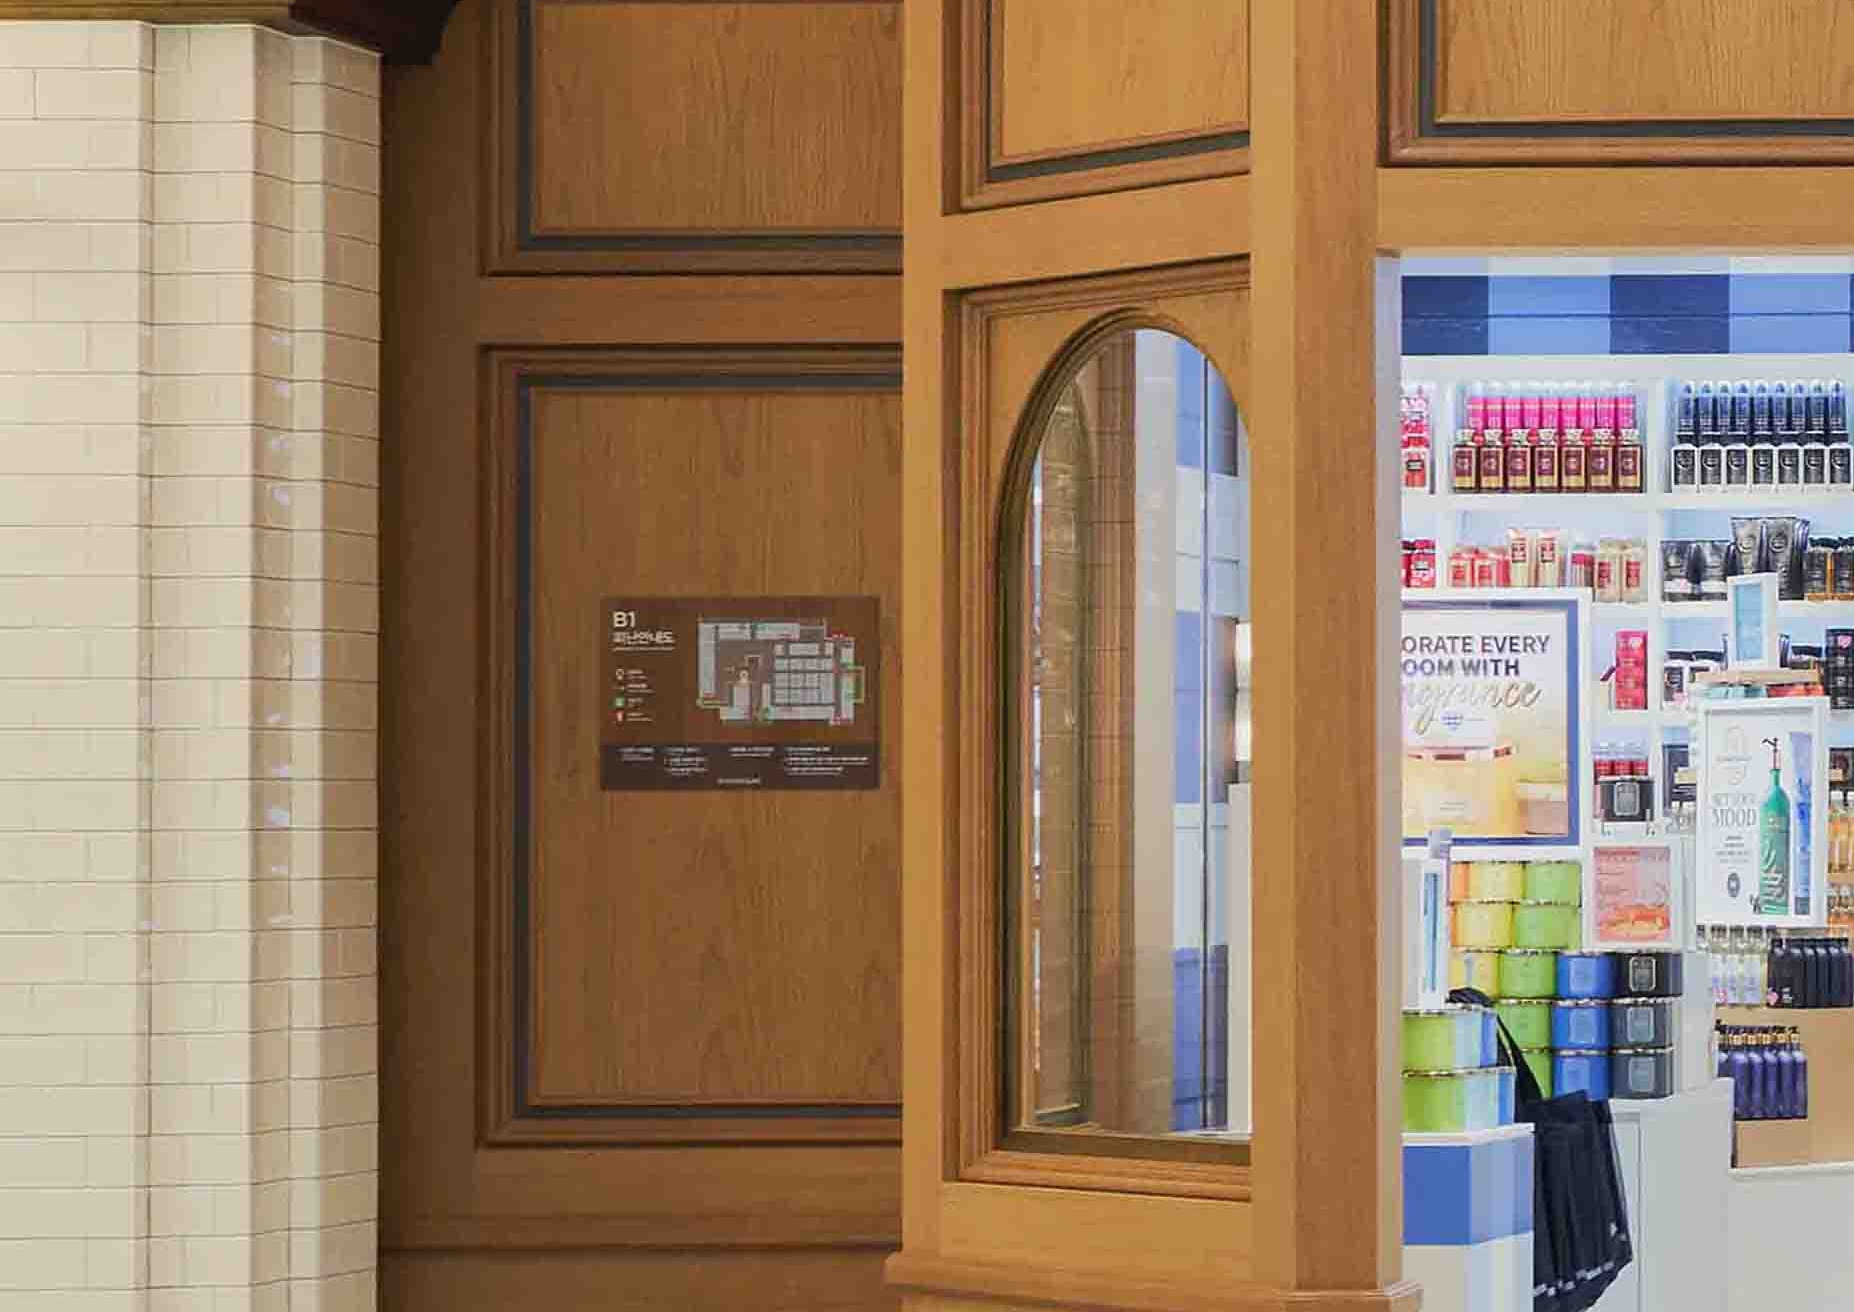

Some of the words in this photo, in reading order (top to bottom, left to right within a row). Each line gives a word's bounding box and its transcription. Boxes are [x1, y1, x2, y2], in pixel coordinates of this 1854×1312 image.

[612, 610, 637, 628] B1
[1401, 635, 1473, 654] ORATE
[1480, 635, 1550, 654] EVERY
[1402, 658, 1455, 677] OOM
[1461, 658, 1520, 677] WITH
